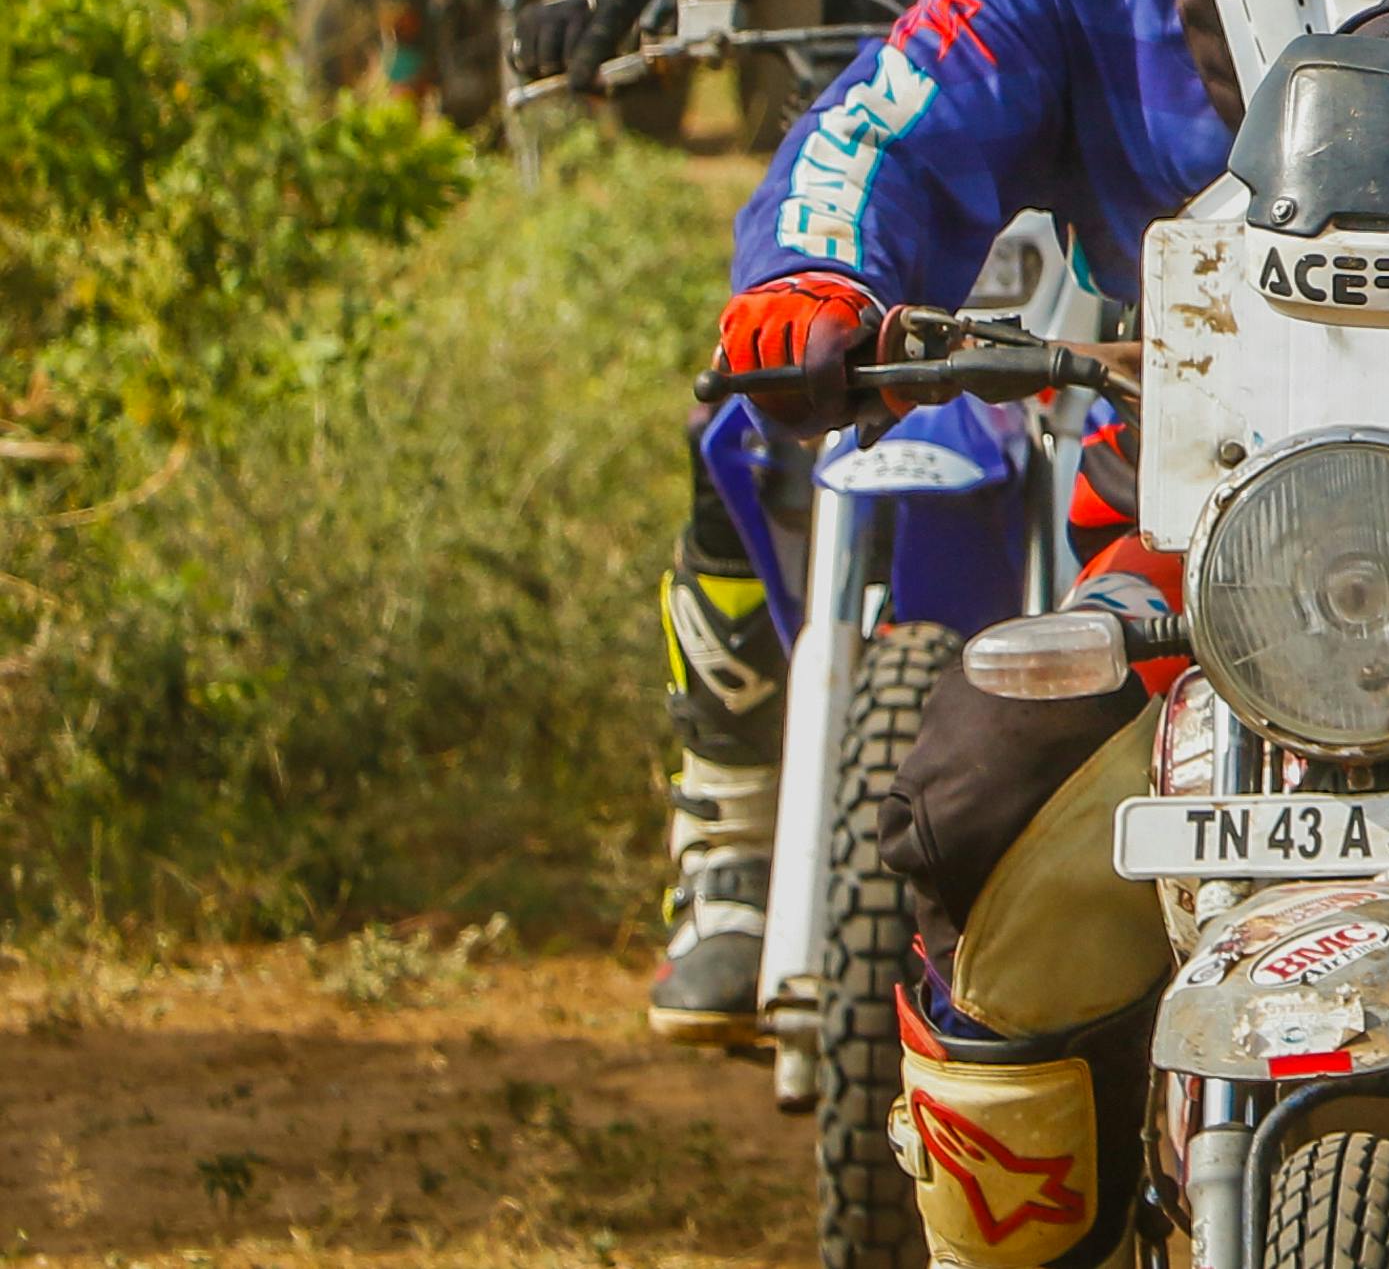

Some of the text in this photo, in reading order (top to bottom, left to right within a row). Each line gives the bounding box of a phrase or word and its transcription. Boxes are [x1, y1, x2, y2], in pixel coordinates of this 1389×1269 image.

[1187, 809, 1249, 861] TN
[1267, 806, 1322, 859] 43
[1340, 804, 1372, 858] A
[1260, 923, 1379, 981] BMC
